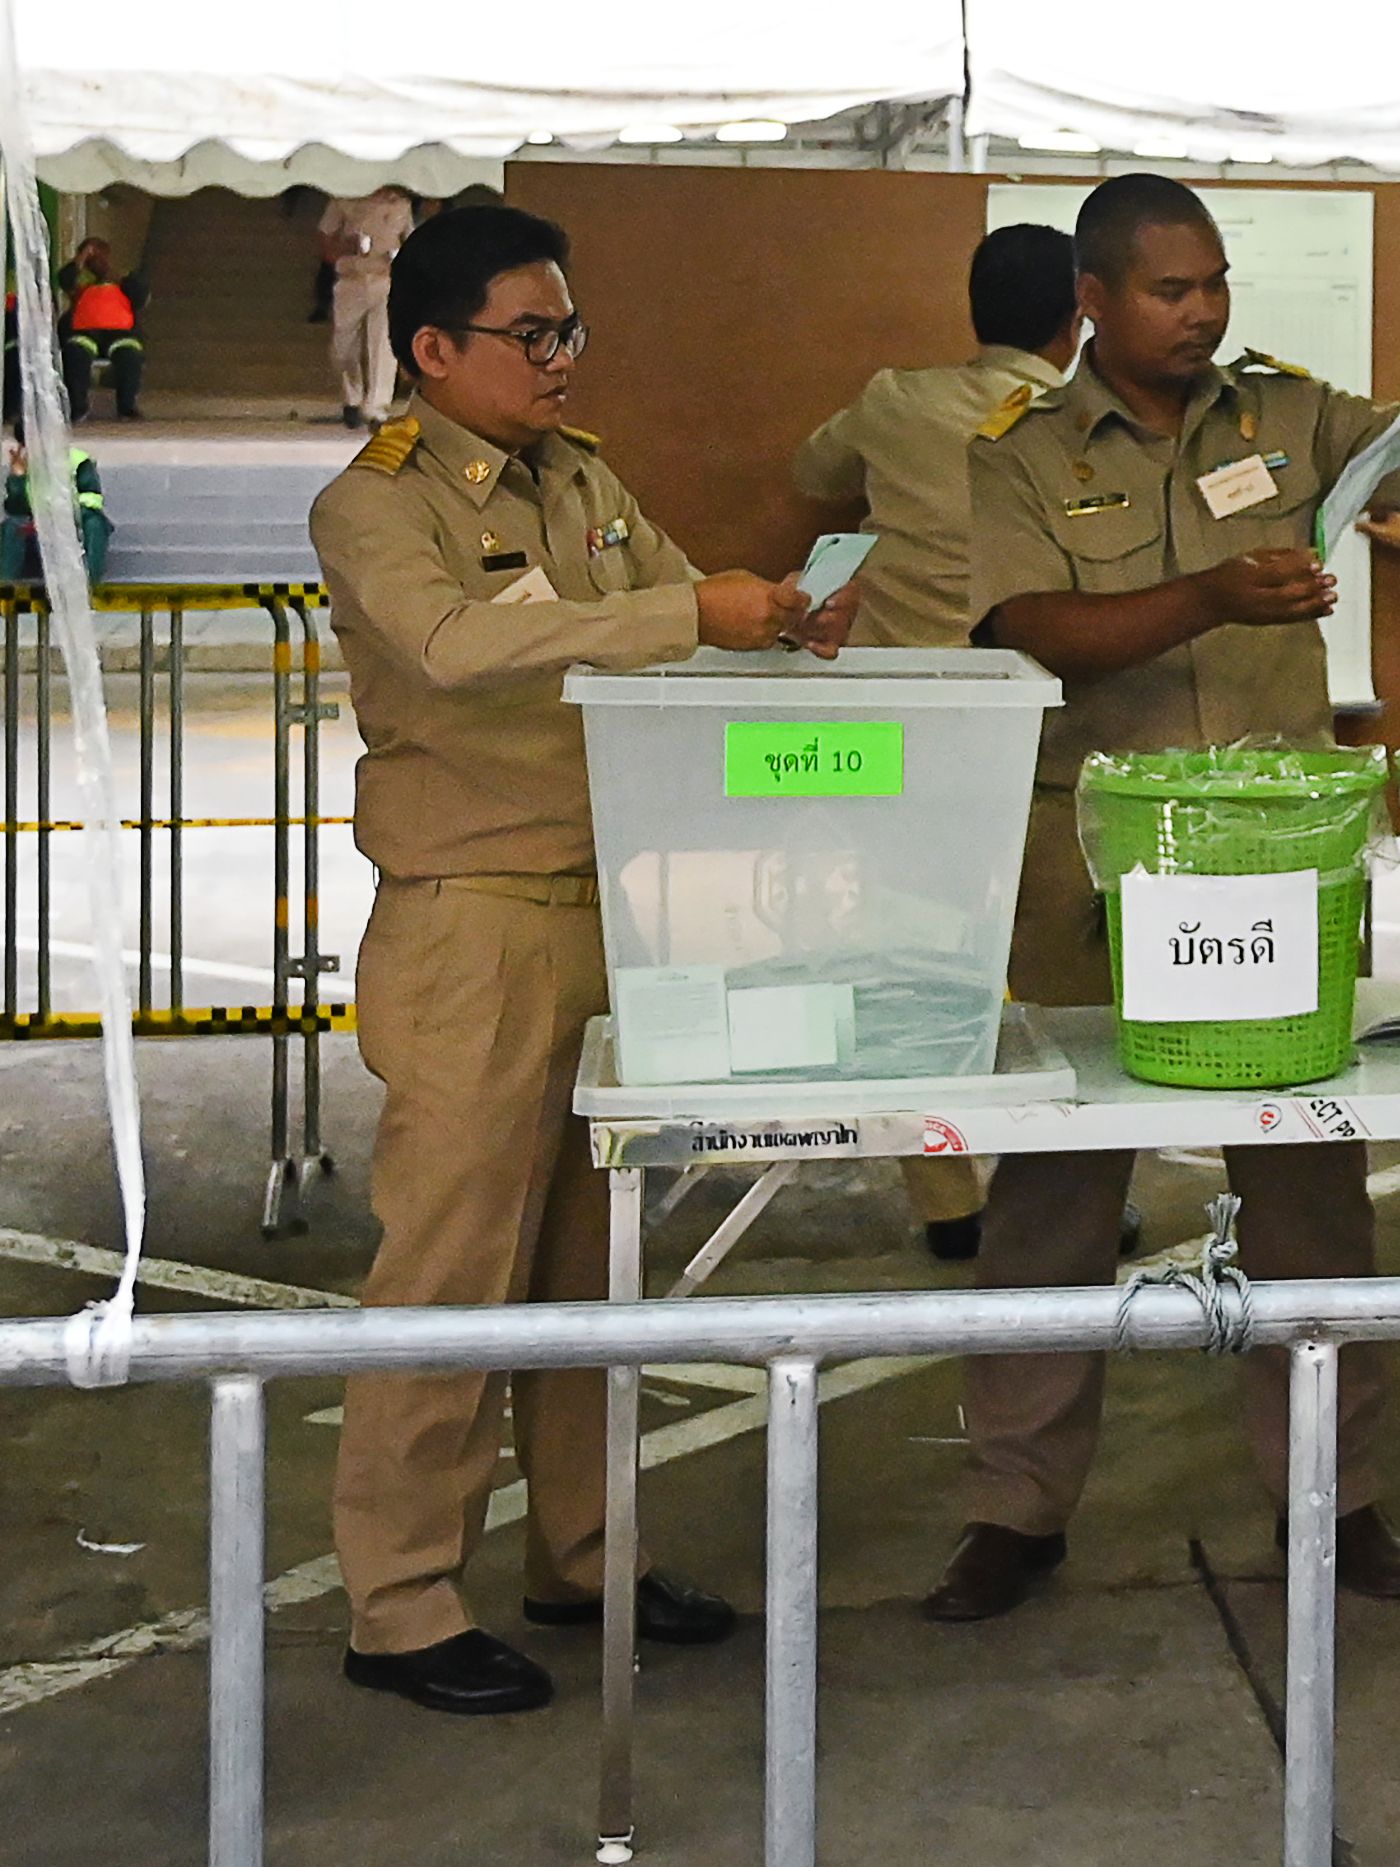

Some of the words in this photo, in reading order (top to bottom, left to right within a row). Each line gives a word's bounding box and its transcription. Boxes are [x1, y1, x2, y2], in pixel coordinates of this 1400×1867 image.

[763, 736, 819, 783] ชุดที่
[832, 749, 863, 773] 10
[1168, 918, 1275, 966] บัตรดี
